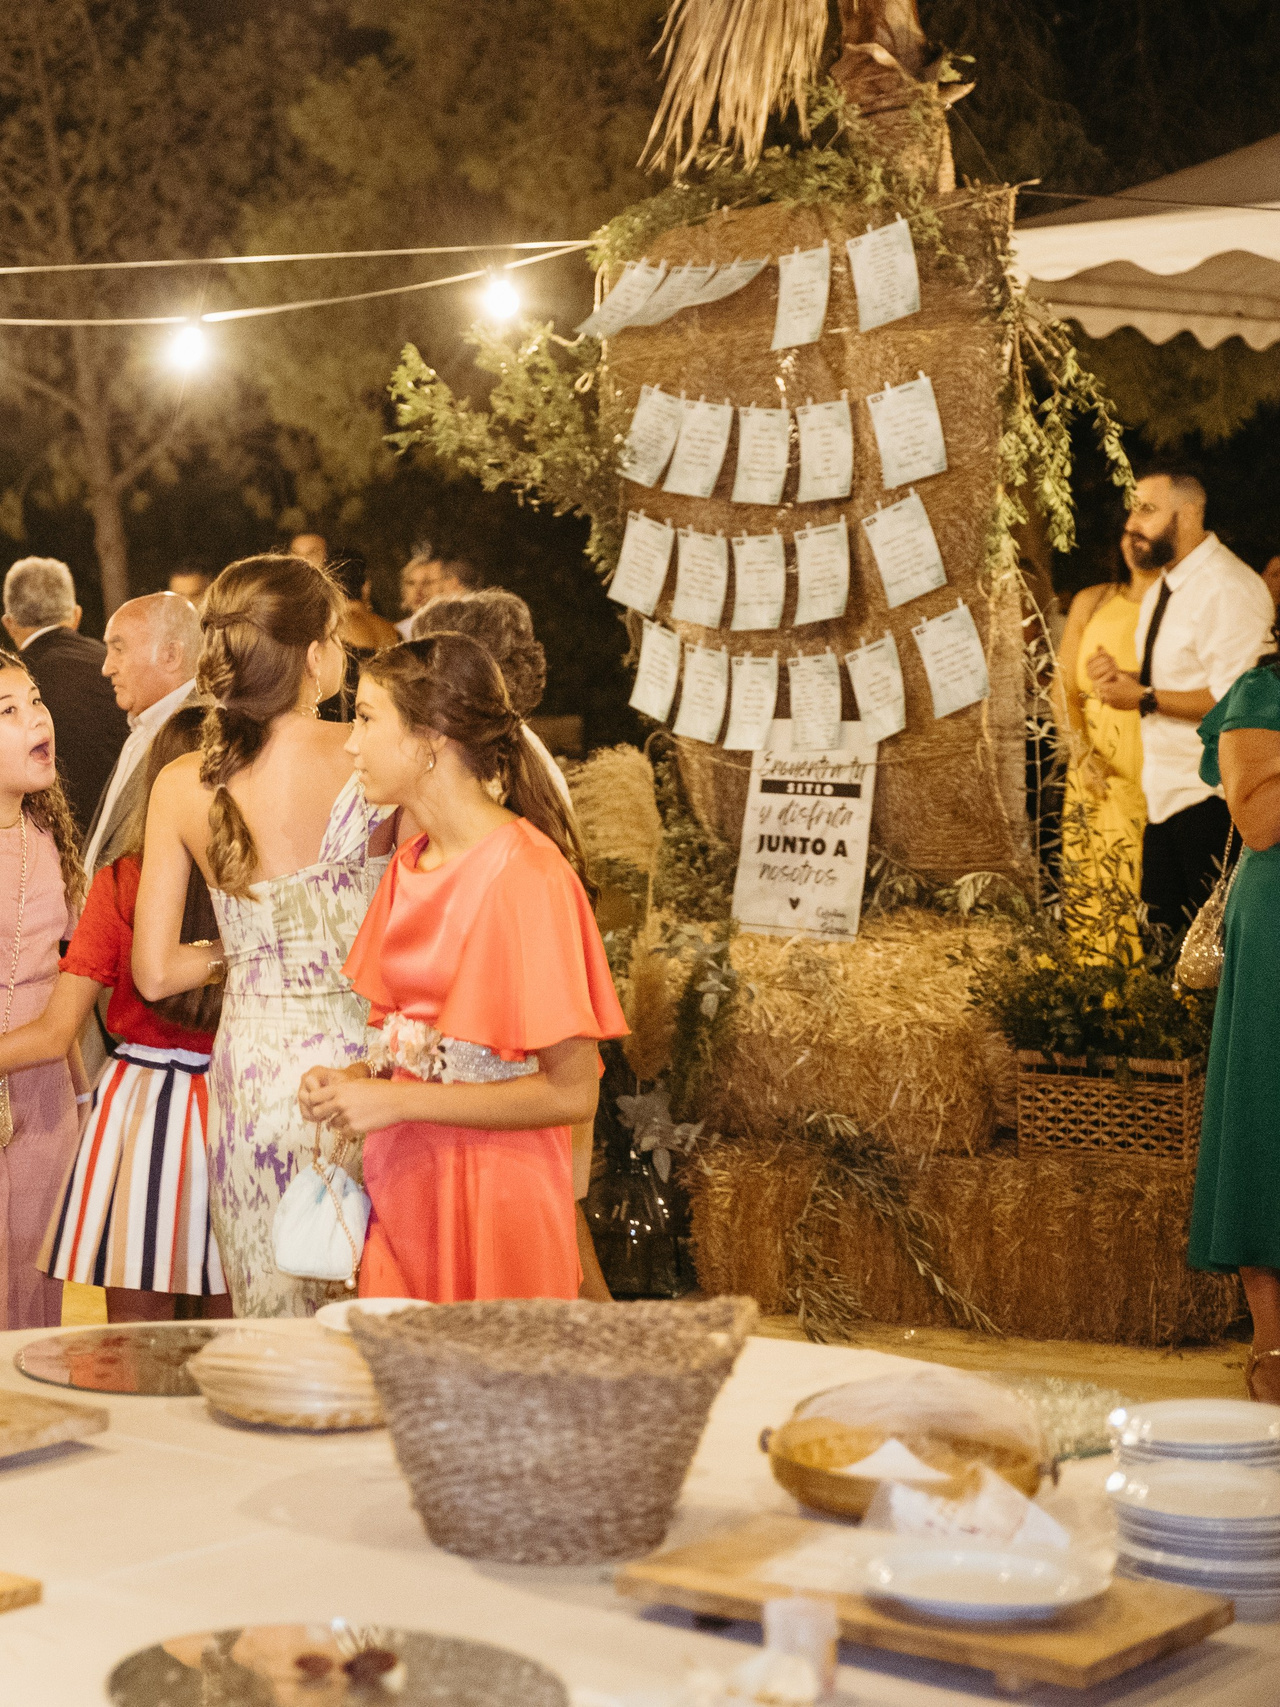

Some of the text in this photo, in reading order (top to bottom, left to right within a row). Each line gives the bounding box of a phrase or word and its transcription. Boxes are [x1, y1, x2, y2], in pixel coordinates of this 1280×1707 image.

[786, 782, 834, 796] SITIO
[759, 800, 854, 830] y disfruta
[756, 834, 848, 857] JUNTO A
[759, 860, 838, 886] nosotros
